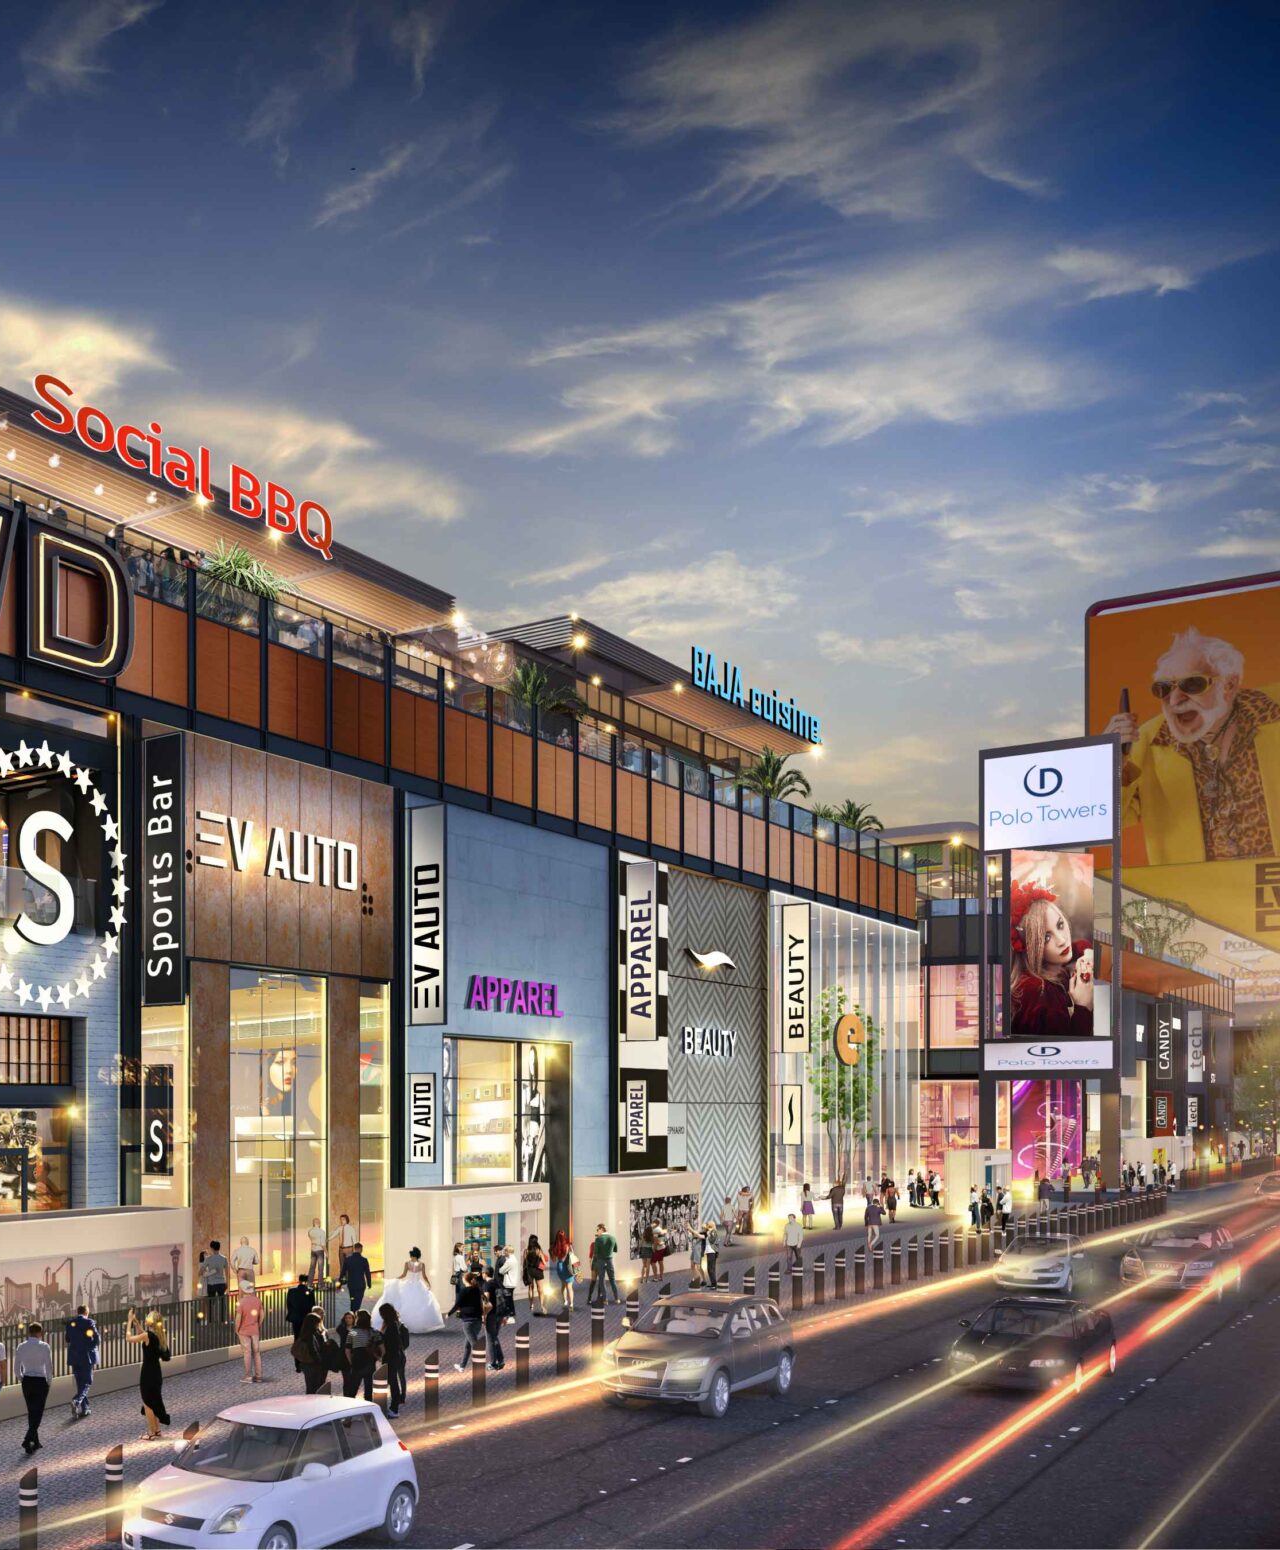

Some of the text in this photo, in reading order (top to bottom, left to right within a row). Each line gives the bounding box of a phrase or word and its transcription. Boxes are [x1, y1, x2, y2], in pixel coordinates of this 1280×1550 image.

[29, 373, 335, 561] Social BBQ
[692, 644, 822, 744] BAJA cuisine
[989, 802, 1108, 827] Polo Towers
[14, 810, 75, 946] S
[147, 774, 179, 977] Sports Bar
[196, 810, 358, 891] EV AUTO
[413, 863, 440, 1009] EV AUTO
[630, 889, 652, 1019] APPAREL
[470, 974, 564, 1018] APPAREL
[788, 933, 805, 1039] BEAUTY
[683, 1026, 737, 1057] BEAUTY
[997, 1058, 1099, 1067] Polo Towers
[1159, 1020, 1170, 1070] CANDY
[1188, 1026, 1203, 1070] tech
[149, 1119, 164, 1163] S
[413, 1082, 431, 1157] EV AUTO
[629, 1084, 644, 1147] APPAREL
[1157, 1099, 1167, 1126] CANDY
